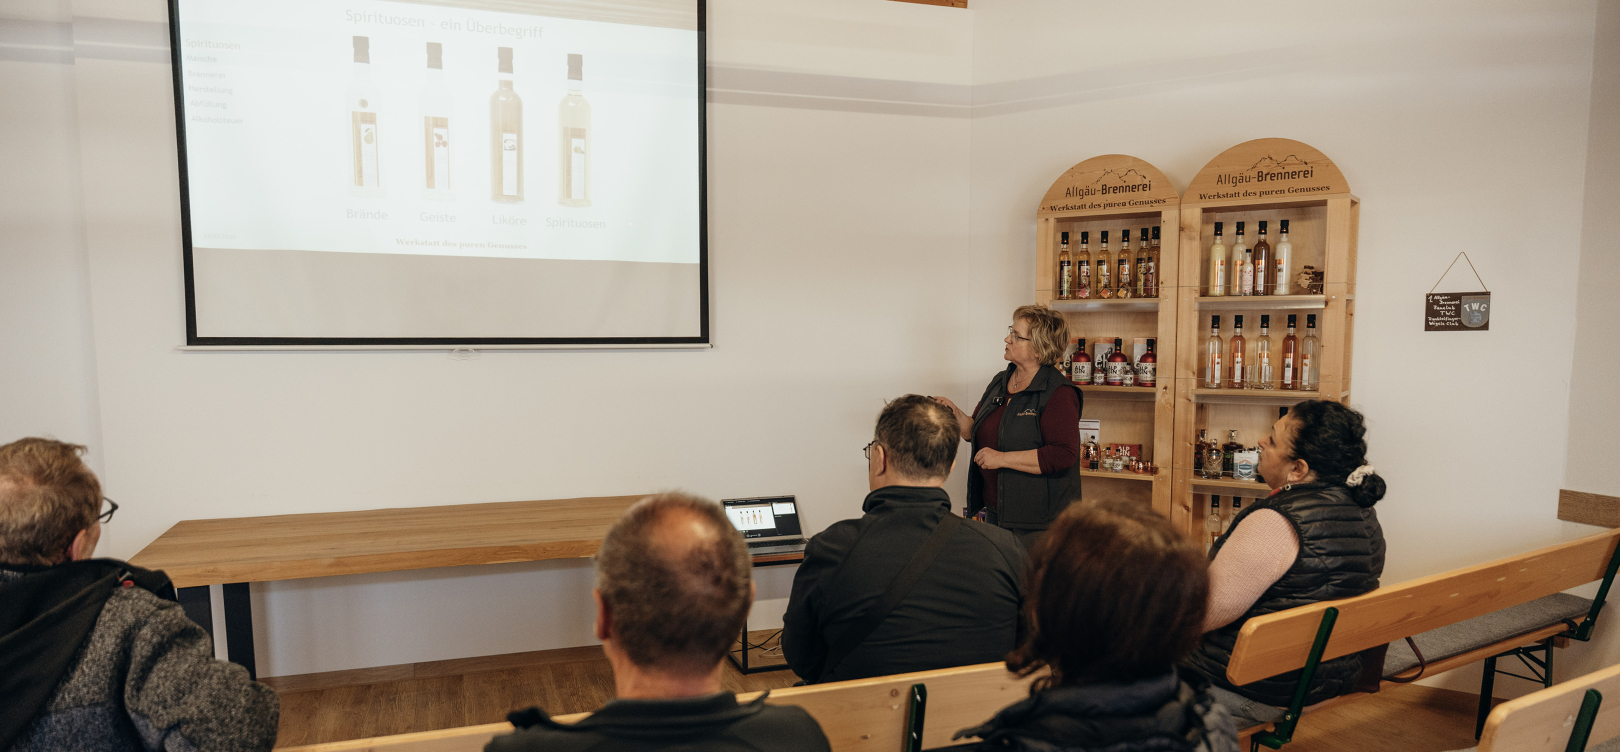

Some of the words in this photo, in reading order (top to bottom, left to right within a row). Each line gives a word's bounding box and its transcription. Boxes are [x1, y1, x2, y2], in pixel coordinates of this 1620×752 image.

[345, 9, 425, 28] Spirituosen
[440, 18, 462, 31] ein
[466, 17, 545, 40] Überbegriff
[185, 38, 241, 50] Spirituosen
[186, 54, 218, 63] Maische
[187, 69, 226, 79] Brennerei
[188, 84, 234, 95] Herstellung
[190, 99, 227, 110] Abfüllung
[191, 115, 244, 124] Alkoholsteuer
[1216, 165, 1314, 188] Allgäu-Brennerei
[1065, 180, 1152, 199] Allgäu-Brennerei
[1199, 191, 1241, 200] Werkstatt
[1242, 189, 1257, 198] des
[1258, 188, 1286, 198] puren
[1287, 185, 1331, 194] Genusses
[1050, 201, 1087, 212] Werkstatt
[1088, 200, 1102, 210] des
[1103, 201, 1127, 210] puren
[1128, 198, 1167, 207] Genusses
[345, 208, 389, 221] Brände
[419, 211, 457, 224] Geiste
[492, 214, 527, 226] Liköre
[545, 217, 606, 230] Spirituosen
[395, 238, 440, 247] Werkstatt
[442, 239, 457, 247] des
[459, 241, 485, 250] puren
[487, 241, 528, 250] Genusses
[1464, 303, 1487, 312] TWC
